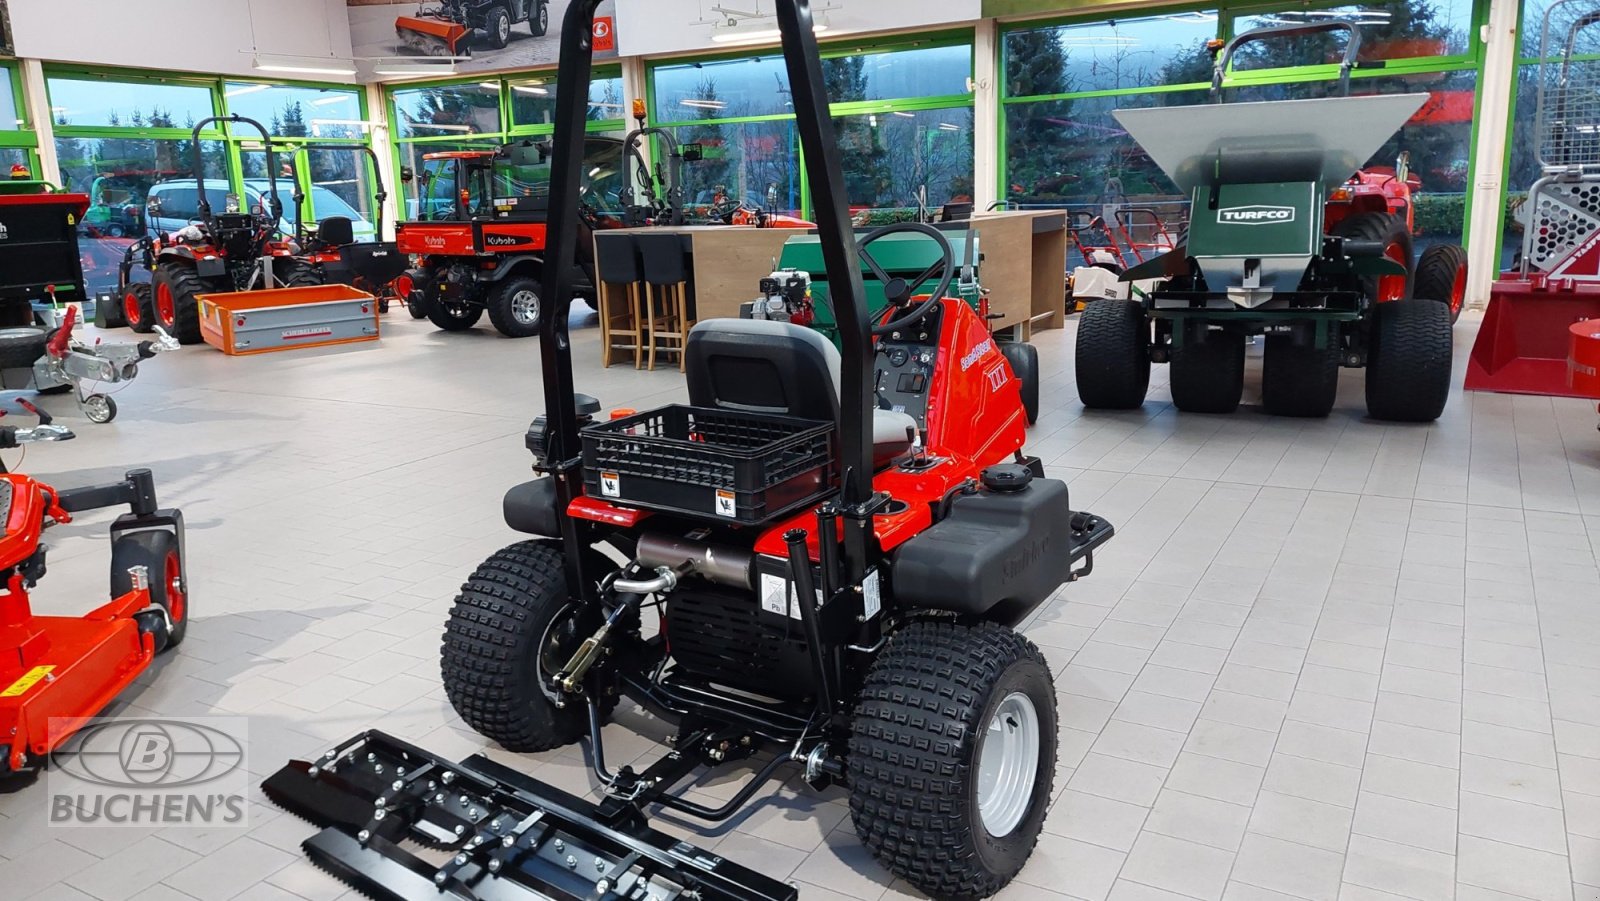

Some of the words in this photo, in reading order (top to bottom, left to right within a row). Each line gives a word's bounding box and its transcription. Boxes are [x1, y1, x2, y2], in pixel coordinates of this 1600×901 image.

[1223, 210, 1290, 220] TURFCO
[487, 237, 516, 245] Kubota
[771, 603, 781, 612] Pb
